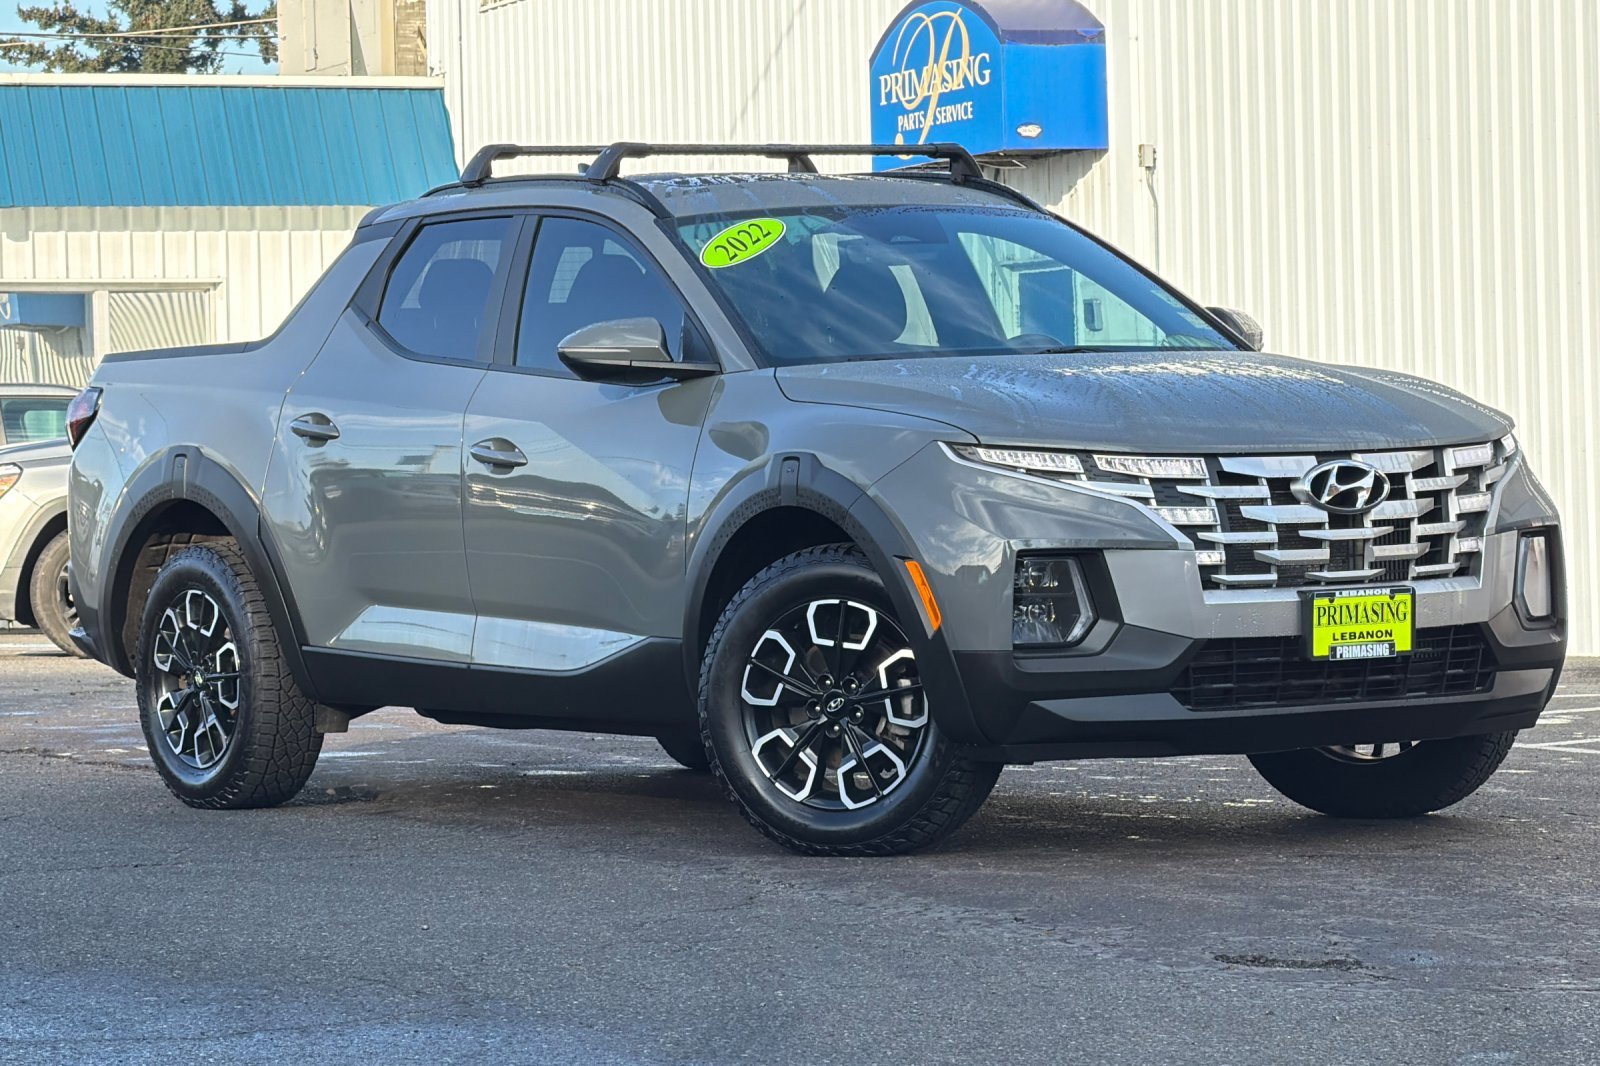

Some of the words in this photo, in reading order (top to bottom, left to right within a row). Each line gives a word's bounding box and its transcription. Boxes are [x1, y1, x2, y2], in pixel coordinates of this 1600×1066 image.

[879, 53, 991, 105] PRIMASING
[898, 111, 924, 132] PARTS
[936, 101, 973, 125] SERVICE
[714, 223, 772, 262] 2022
[1335, 588, 1391, 598] LEBANON
[1314, 600, 1408, 628] PRIMASING
[1332, 629, 1393, 641] LEBANON
[1336, 643, 1390, 659] PRIMASING
